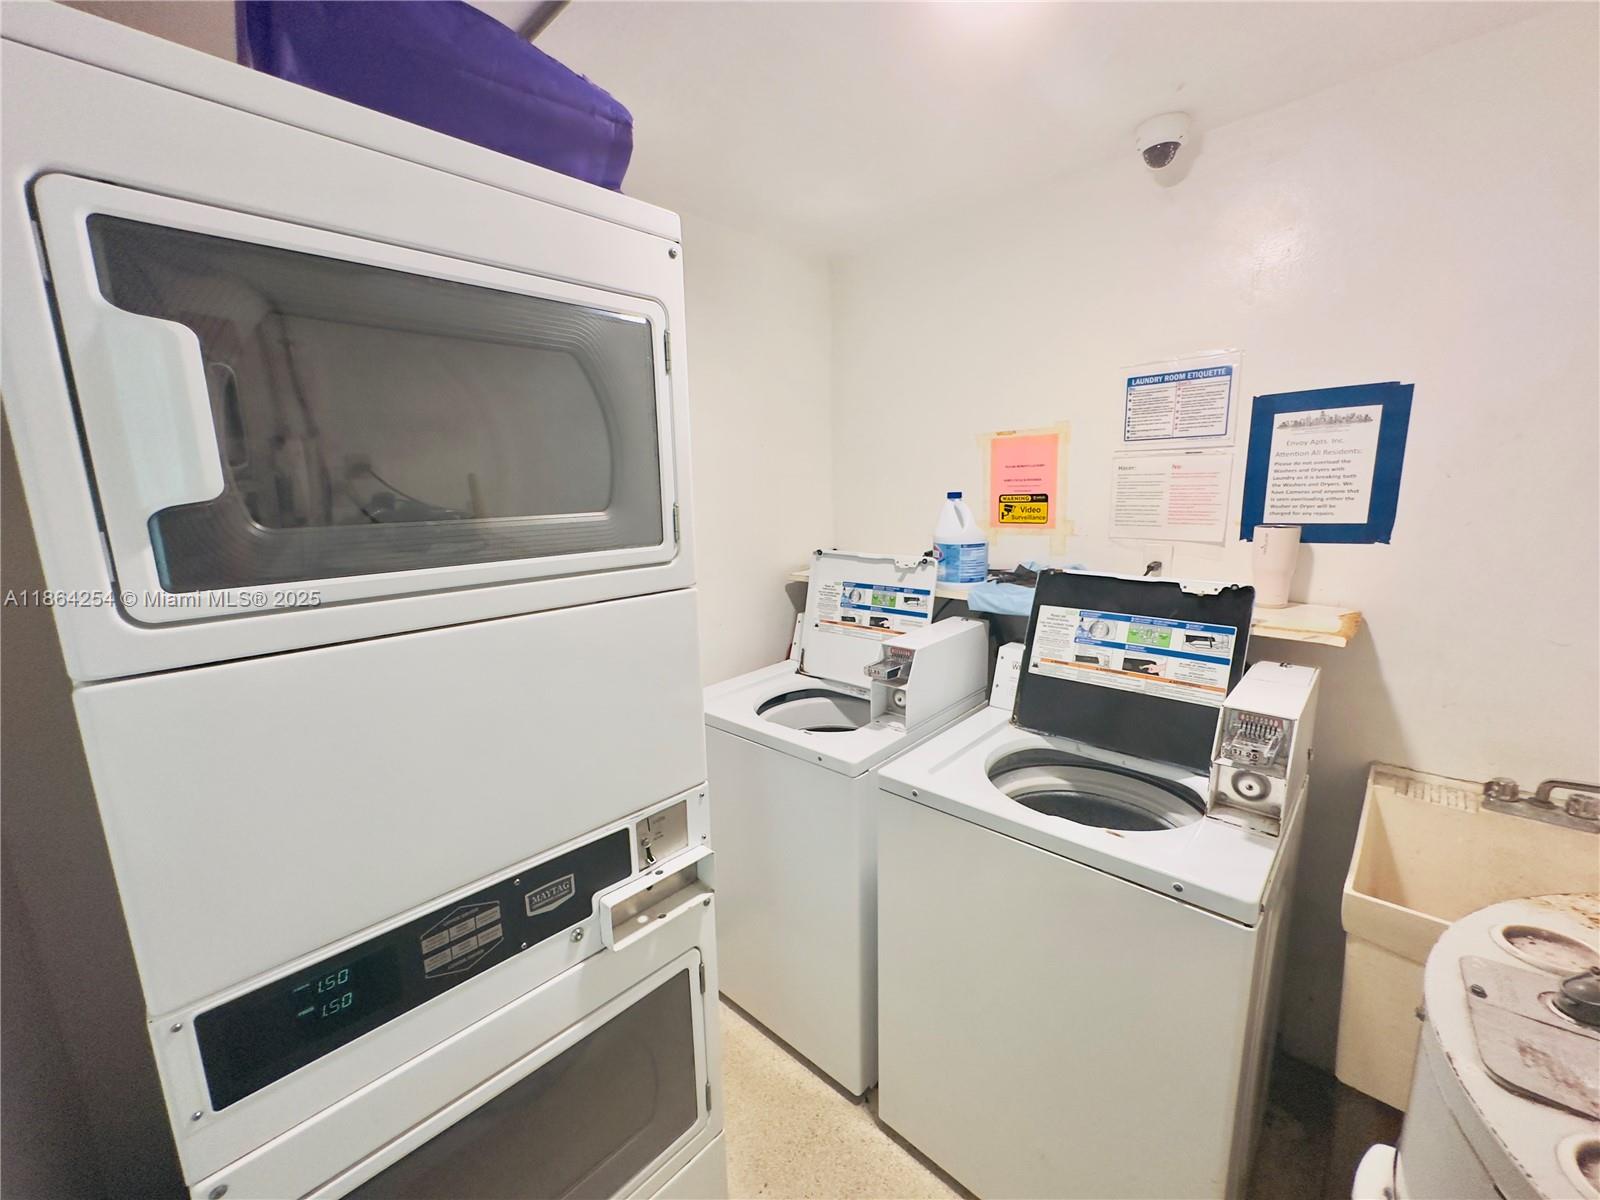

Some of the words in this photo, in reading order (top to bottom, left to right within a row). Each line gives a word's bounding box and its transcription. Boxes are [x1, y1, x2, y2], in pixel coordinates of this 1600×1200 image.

[1132, 376, 1163, 385] LAUNDRY
[1164, 373, 1186, 382] ROOM
[1187, 368, 1226, 380] ETIQUETTE
[532, 881, 570, 905] MAYTAG
